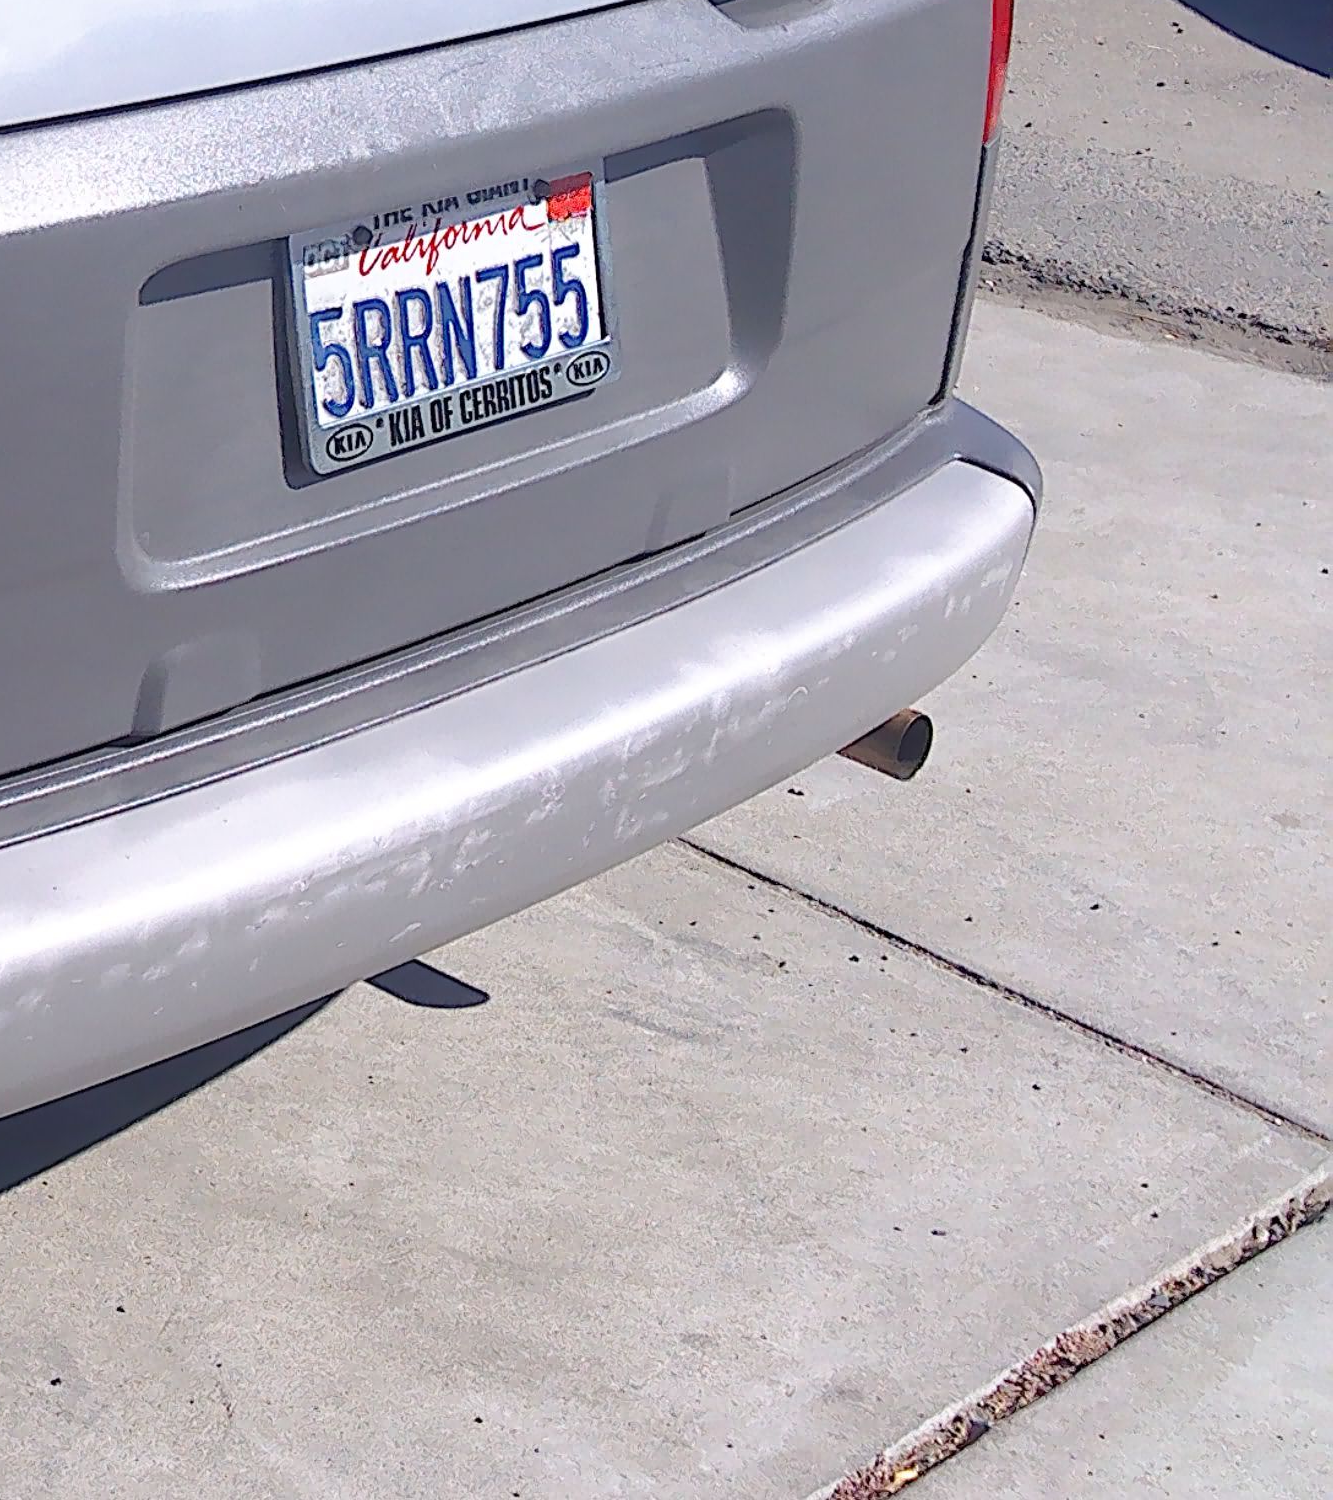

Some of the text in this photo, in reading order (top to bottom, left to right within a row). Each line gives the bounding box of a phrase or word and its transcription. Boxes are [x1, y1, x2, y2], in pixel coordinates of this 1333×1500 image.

[357, 204, 545, 277] California
[310, 243, 589, 418] 5RRN755
[573, 357, 604, 380] KIA
[334, 430, 368, 455] KIA
[388, 366, 553, 447] KIA OF CERRITOS
